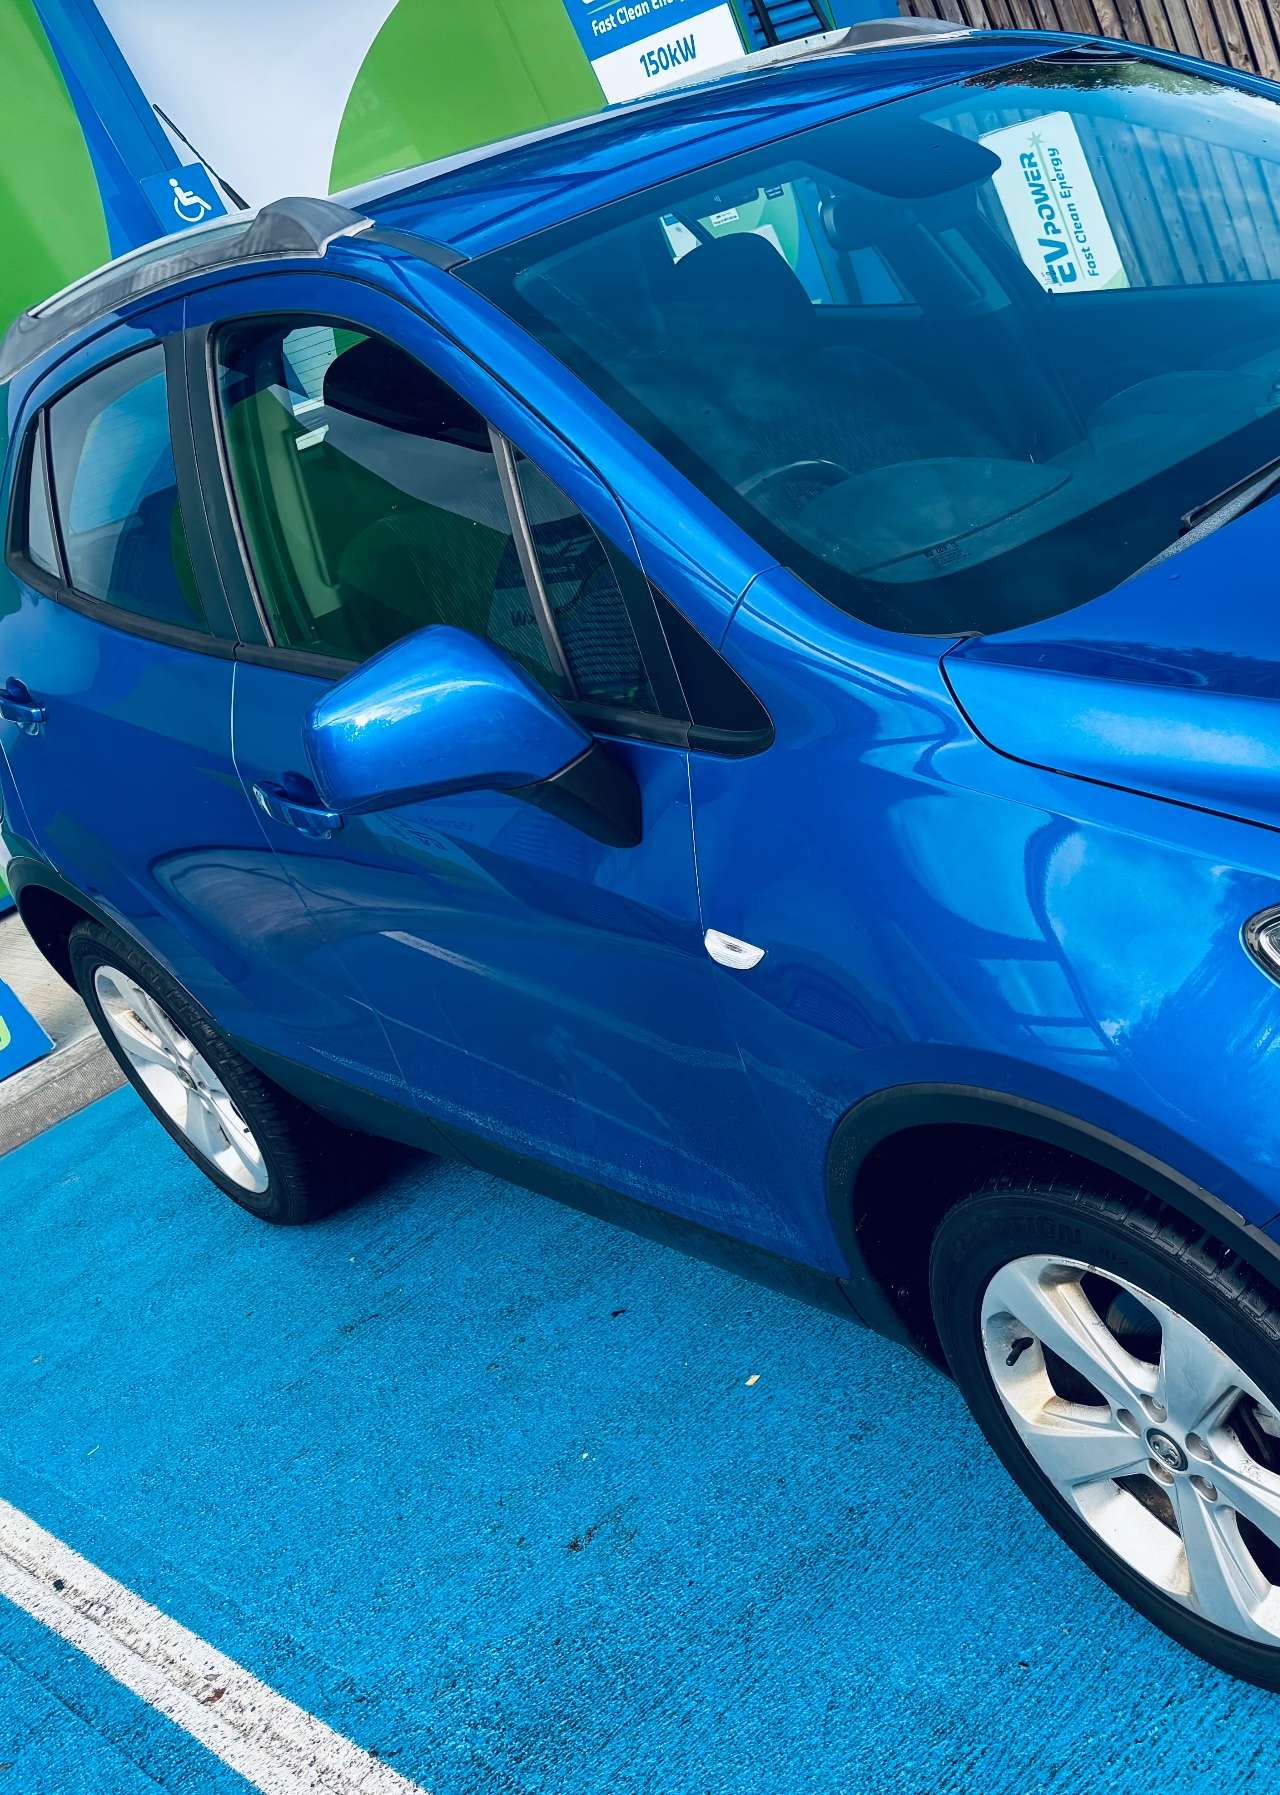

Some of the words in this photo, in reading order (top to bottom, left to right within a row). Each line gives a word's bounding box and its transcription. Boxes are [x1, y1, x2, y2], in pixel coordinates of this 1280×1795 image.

[592, 13, 617, 36] Fast
[616, 1, 650, 25] Clean
[639, 34, 697, 78] 150kW
[1019, 151, 1062, 236] POWER
[1047, 147, 1073, 199] Energy
[1067, 203, 1087, 244] Clean
[1037, 238, 1078, 284] EV
[1081, 247, 1100, 277] Fast
